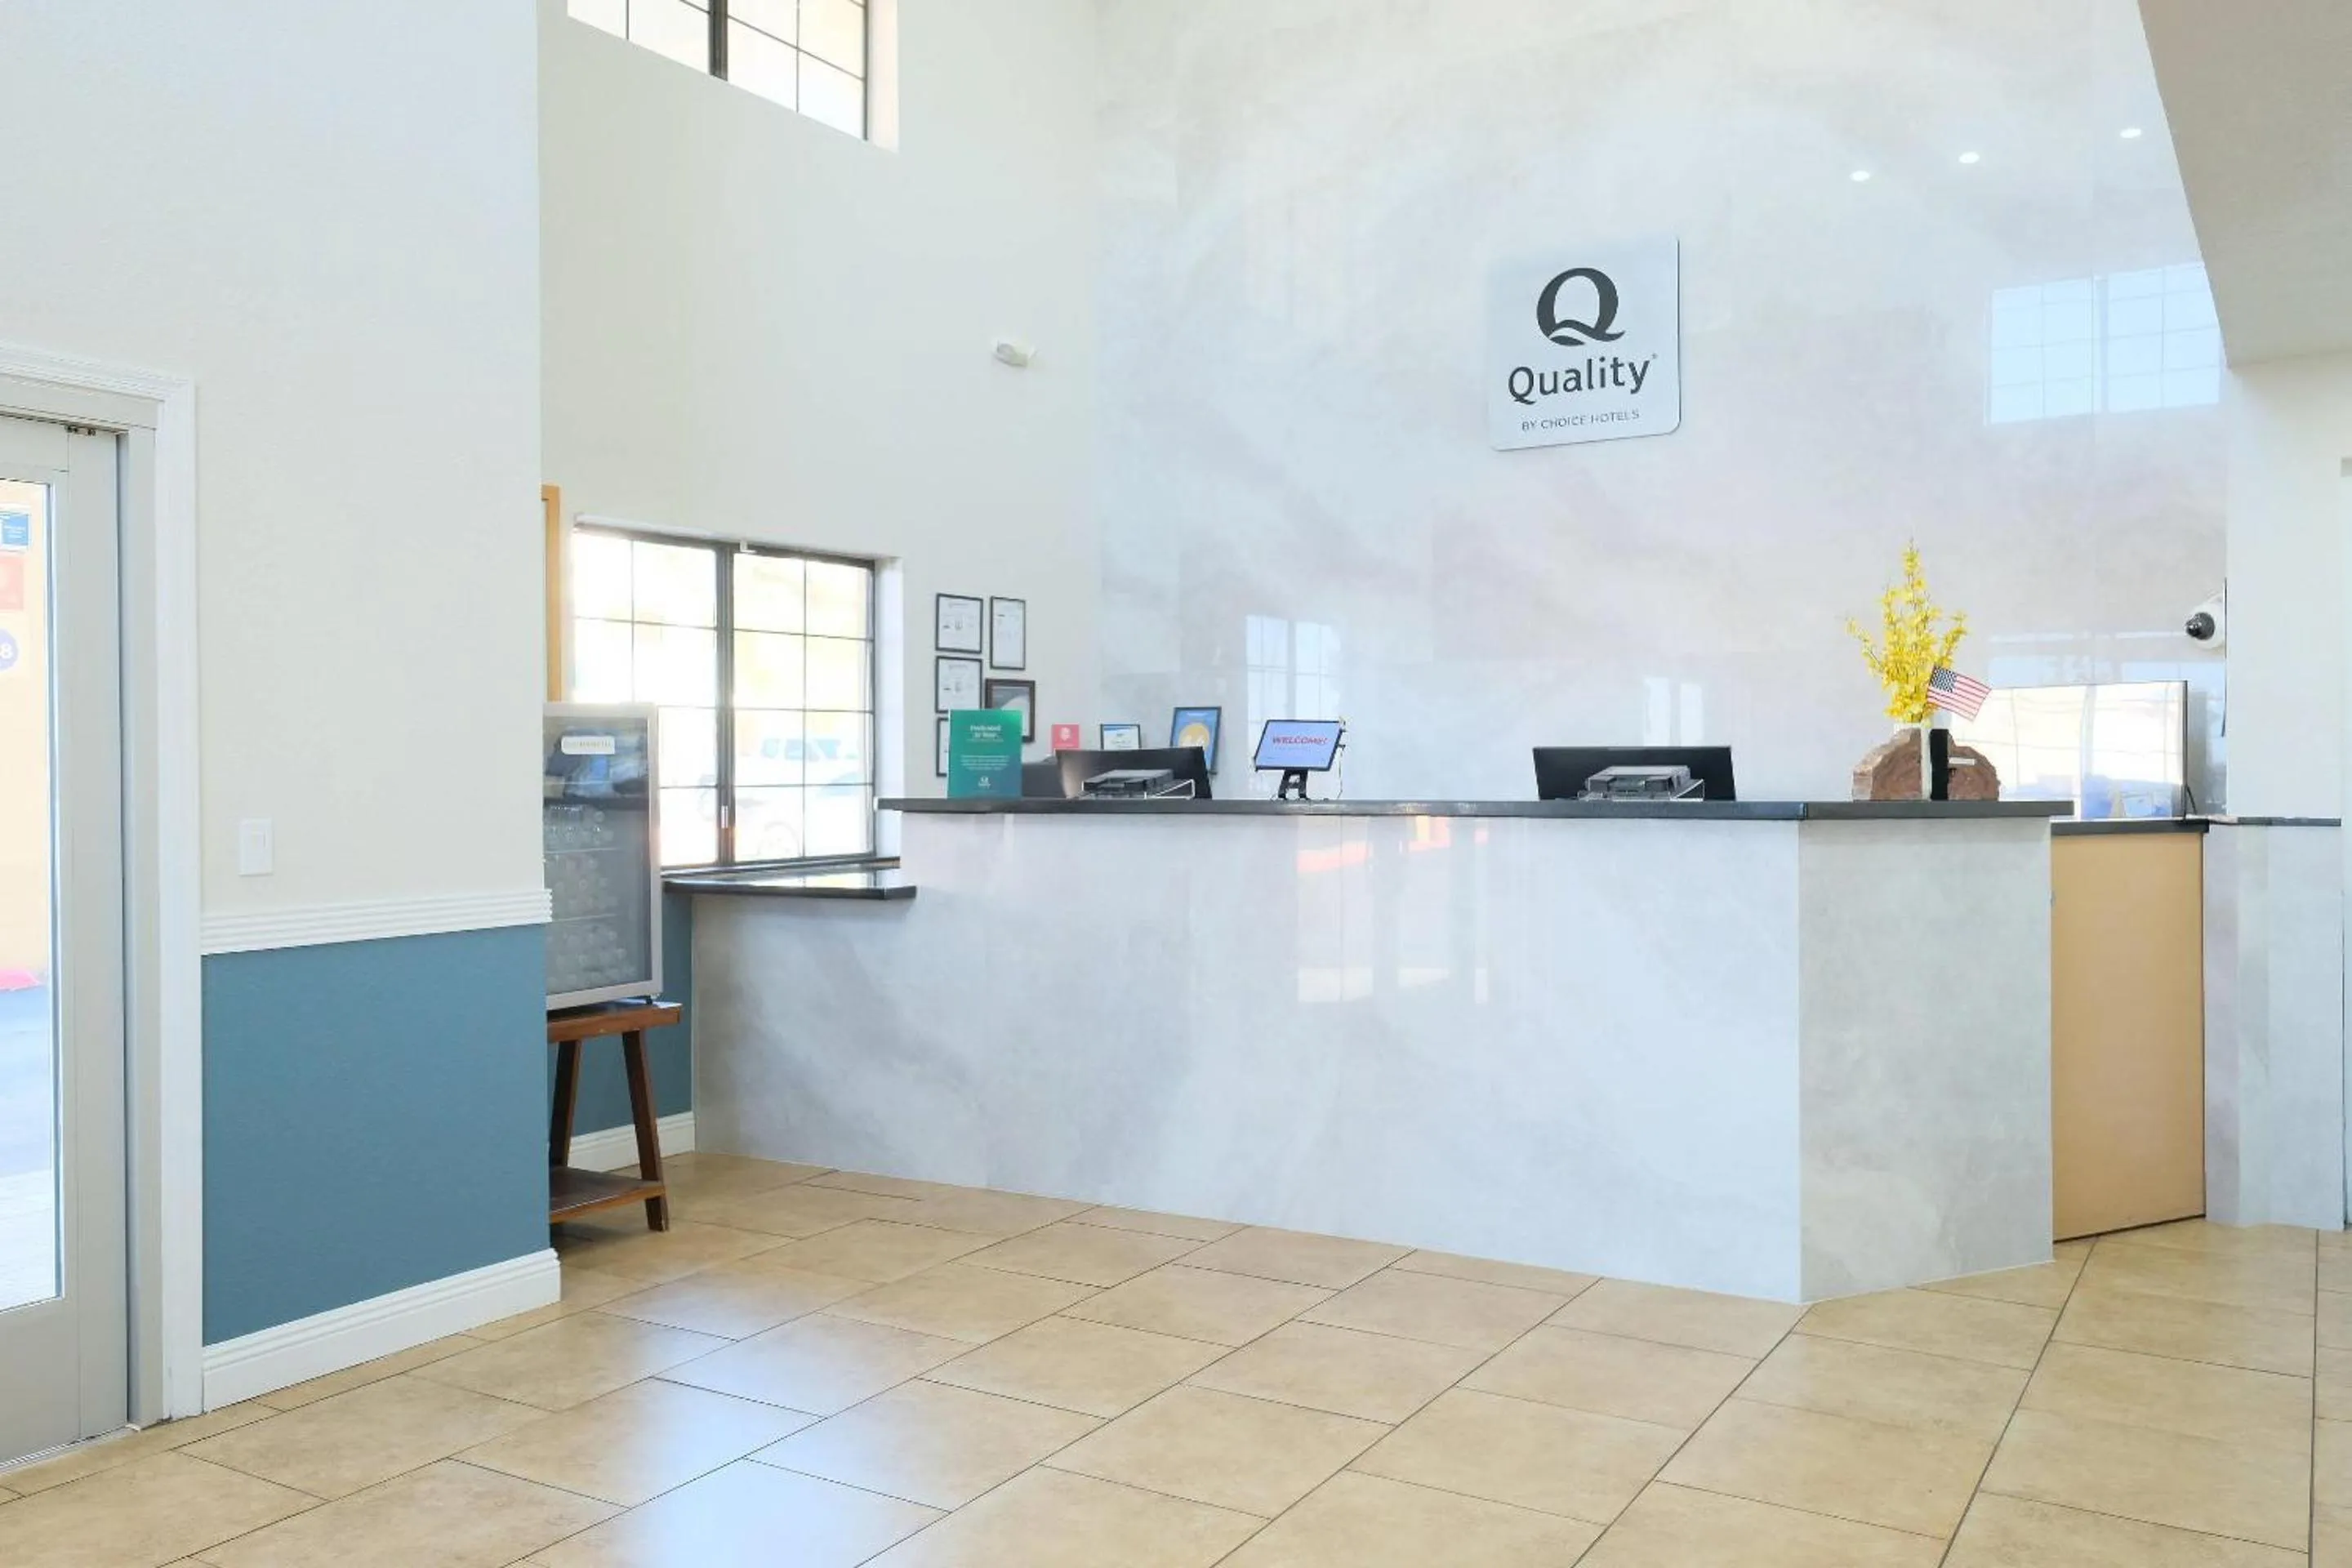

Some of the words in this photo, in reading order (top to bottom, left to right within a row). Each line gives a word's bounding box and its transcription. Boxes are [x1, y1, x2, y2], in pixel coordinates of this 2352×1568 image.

[1536, 267, 1625, 346] Q
[1508, 356, 1650, 405] Quality
[1521, 420, 1537, 431] BY
[1540, 414, 1586, 429] CHOICE
[1591, 408, 1640, 423] HOTELS
